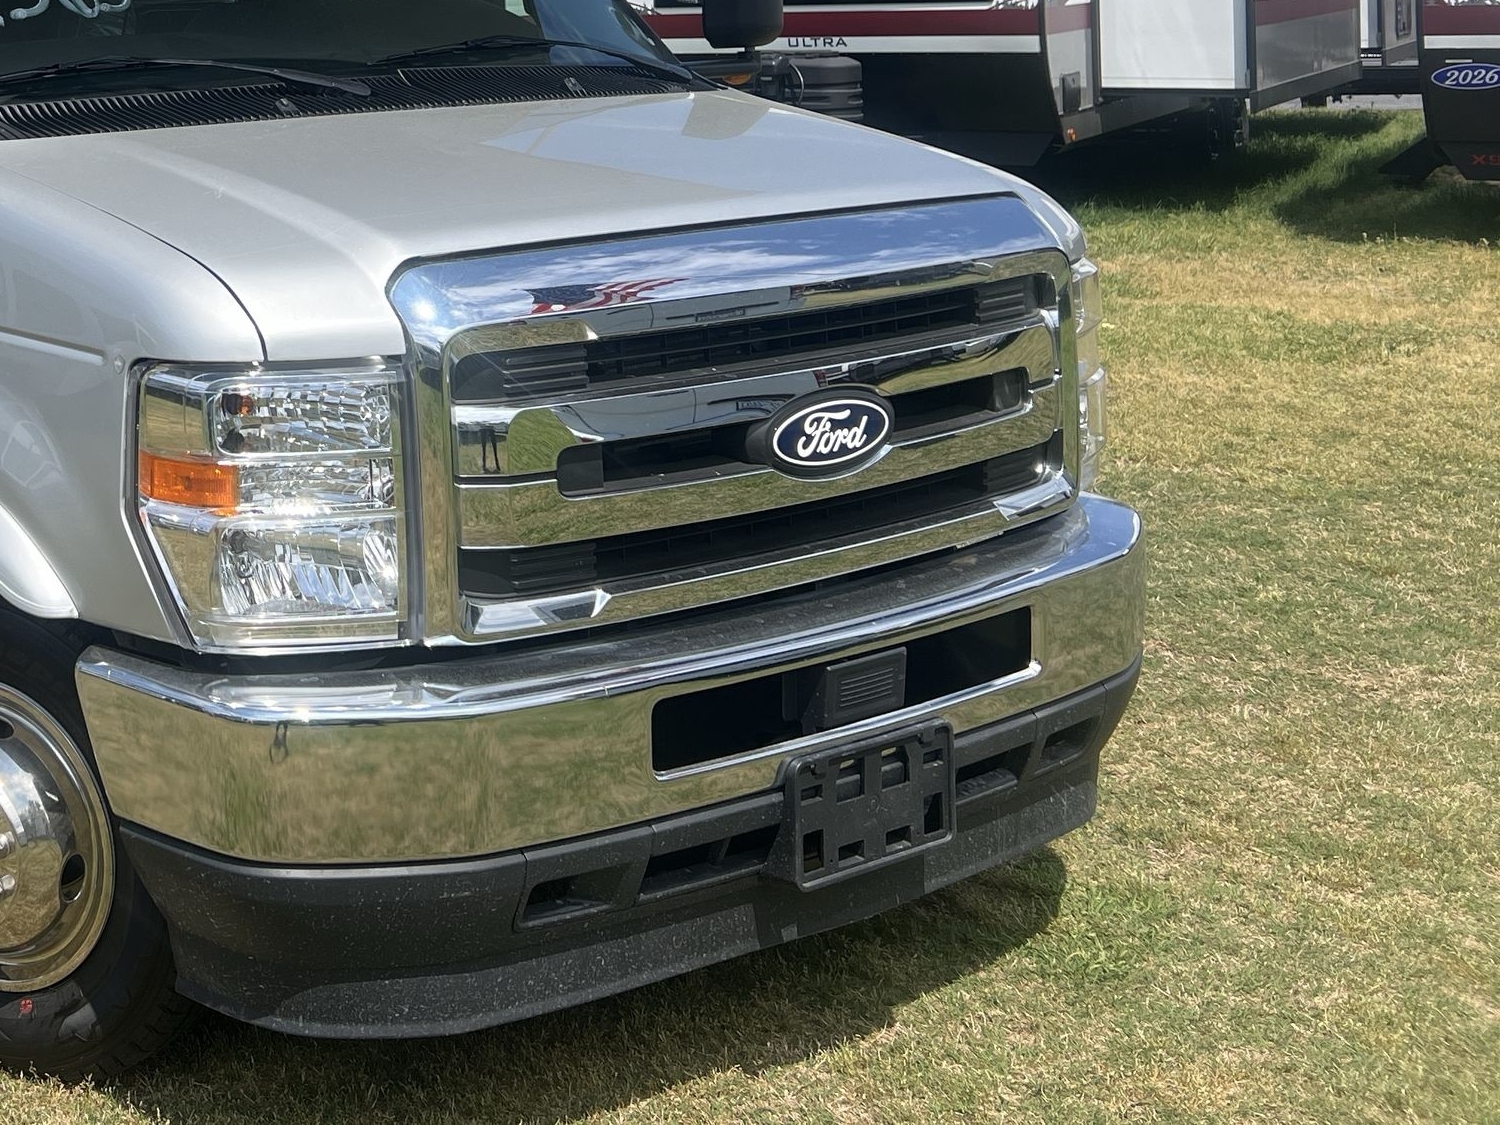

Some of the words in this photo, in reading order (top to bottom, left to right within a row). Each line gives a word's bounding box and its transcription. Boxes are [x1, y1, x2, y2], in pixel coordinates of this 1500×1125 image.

[787, 37, 847, 48] ULTRA
[1444, 68, 1499, 85] 2026
[797, 408, 868, 458] Ford
